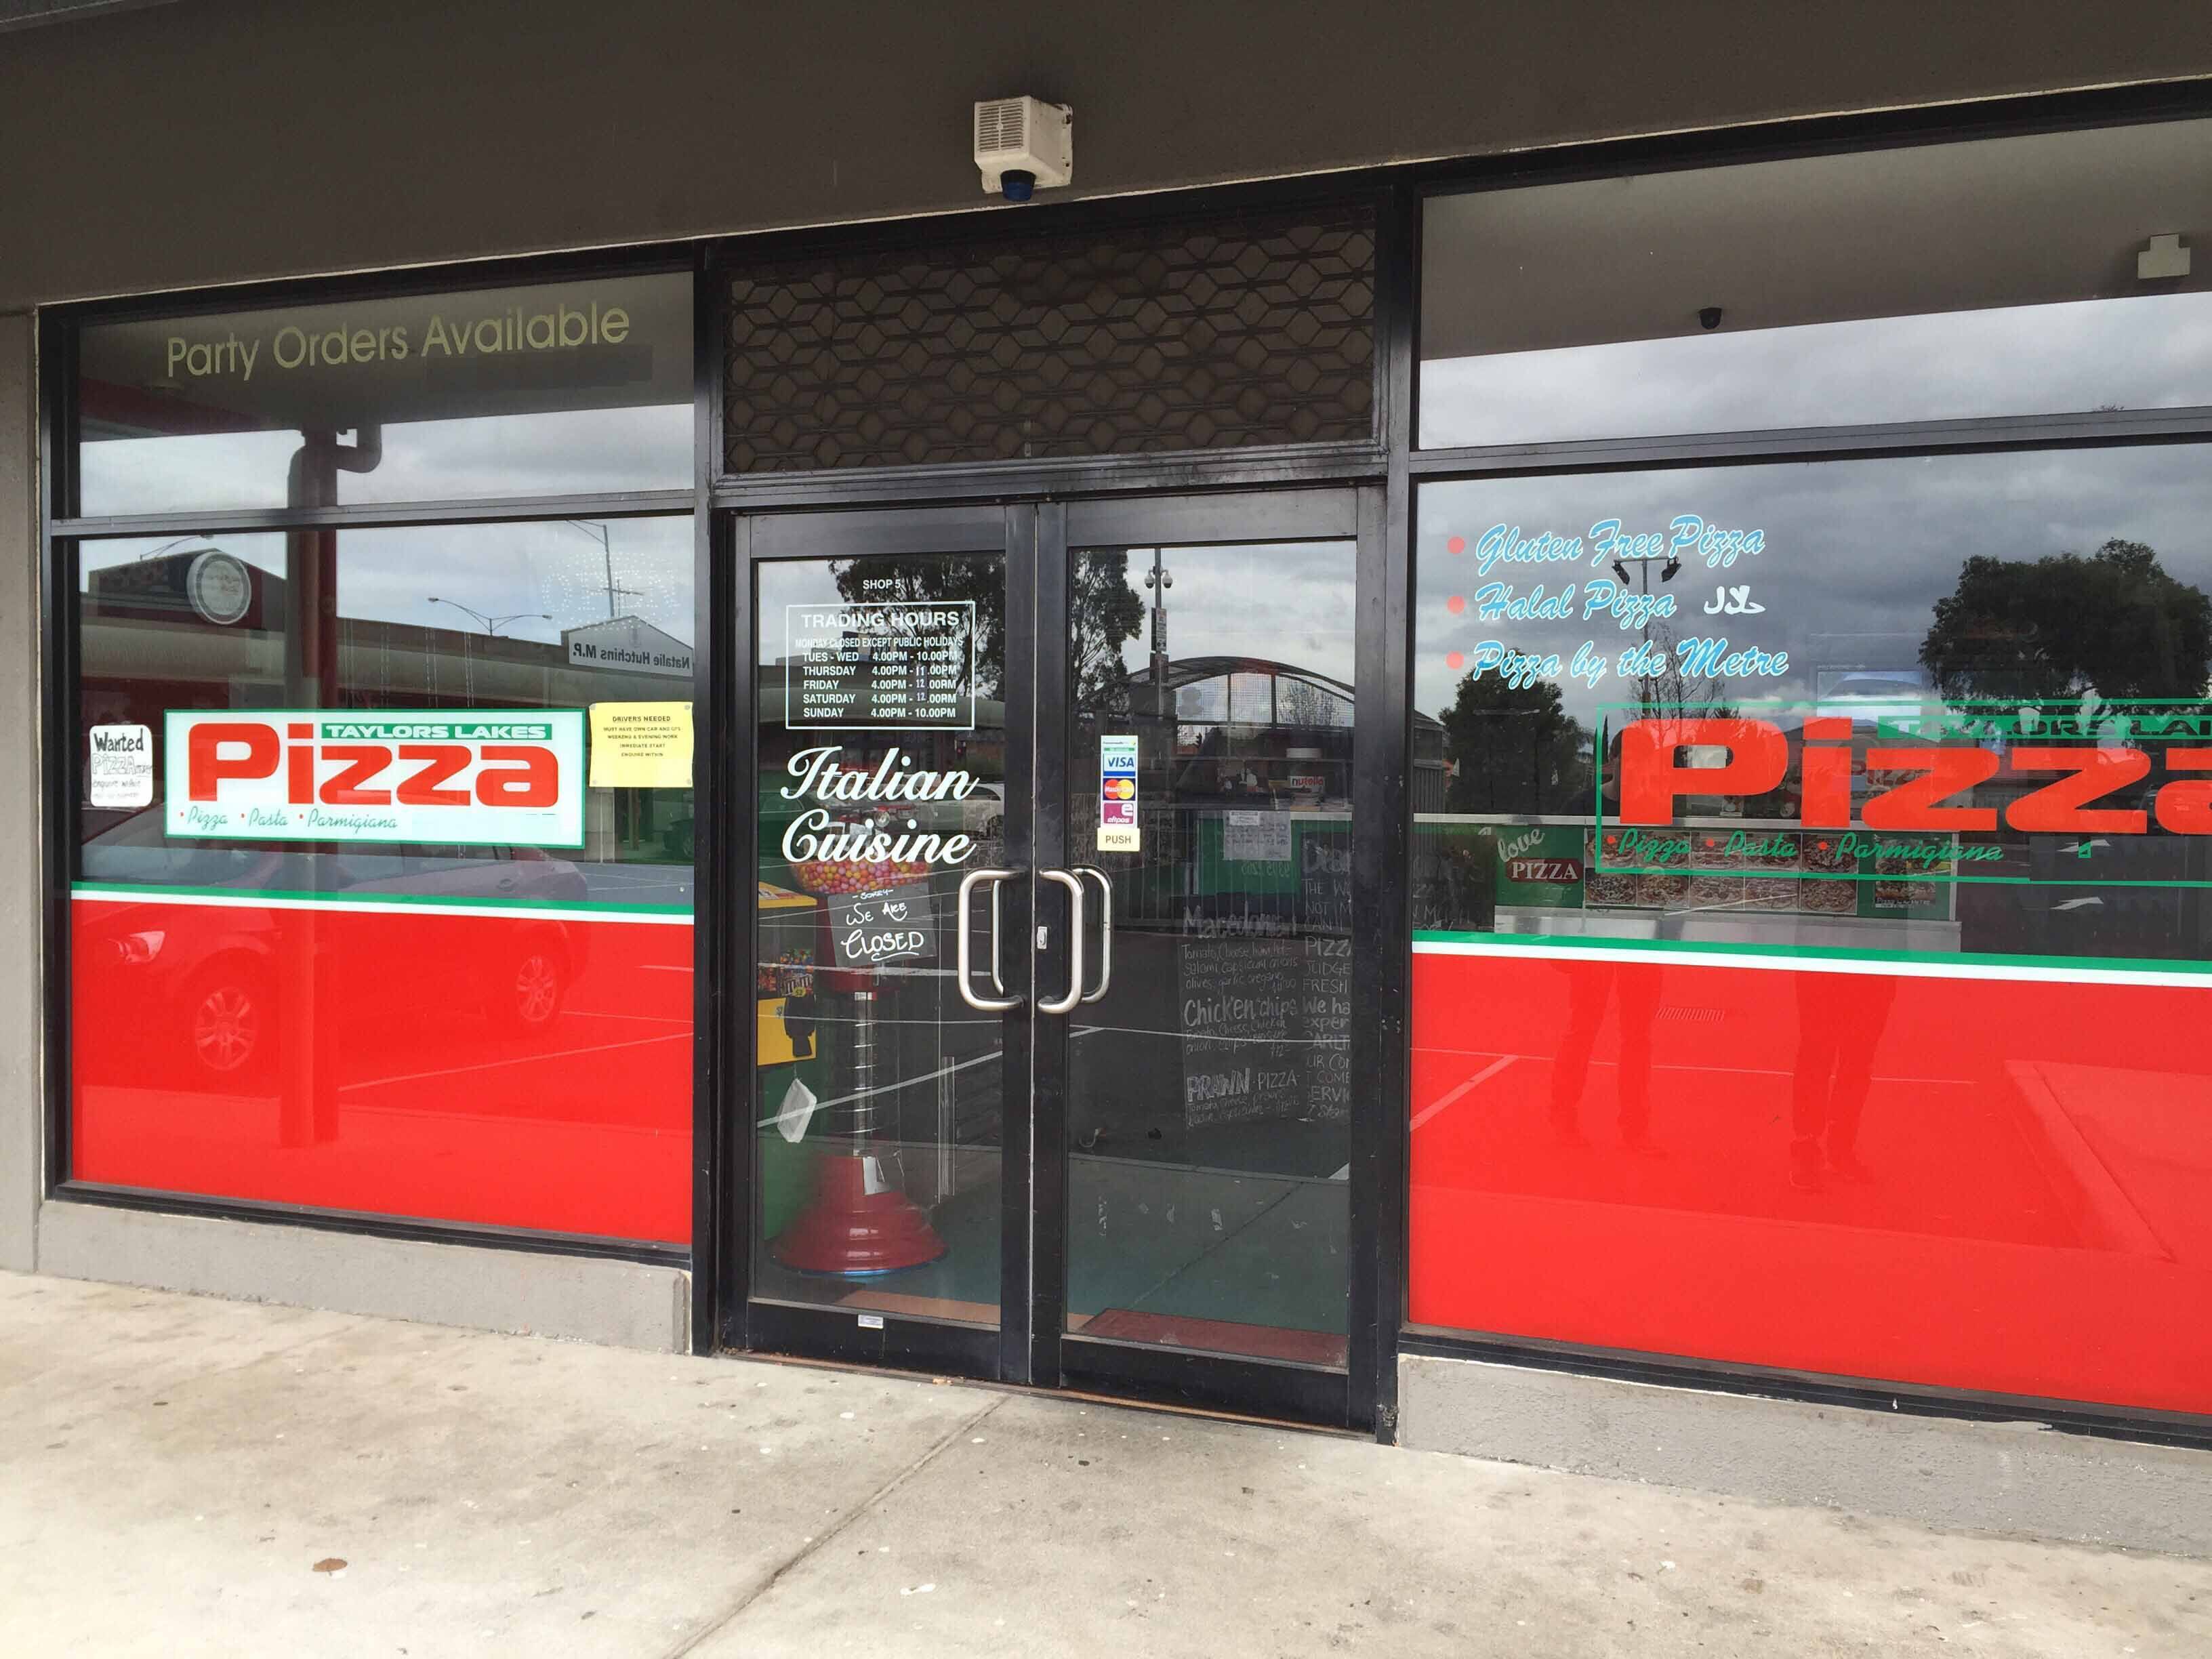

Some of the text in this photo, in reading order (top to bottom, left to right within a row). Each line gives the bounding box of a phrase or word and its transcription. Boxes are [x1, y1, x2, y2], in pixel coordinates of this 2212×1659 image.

[168, 302, 630, 381] Party Orders Available
[1475, 514, 1765, 576] Gluten Free Pizza
[863, 579, 901, 590] SHOP 5
[1475, 579, 1677, 630] Halal Pizza
[801, 611, 960, 628] TRADING HOURS
[795, 636, 964, 648] MONDAY CLOSED EXCEPT PUBLIC HOLIDAYS
[802, 653, 828, 662] TUES
[836, 652, 859, 661] WED
[872, 652, 907, 661] 4.00PM
[917, 651, 958, 661] 10.00PM
[1473, 637, 1789, 690] Pizza by the Metre
[803, 666, 856, 676] THURSDAY
[872, 665, 907, 675] 4.00PM
[916, 665, 957, 676] 11.00PM
[804, 680, 839, 690] FRIDAY
[872, 680, 906, 689] 4.00PM
[803, 694, 856, 703] SATURDAY
[872, 694, 906, 703] 4.00PM
[803, 708, 844, 718] SUNDAY
[871, 708, 906, 718] 4.00PM
[915, 708, 956, 718] 10.00PM
[94, 727, 144, 753] Wanted
[326, 725, 547, 739] TAYLORS LAKES
[188, 722, 558, 808] Pizza
[1107, 757, 1134, 767] VISA
[780, 746, 980, 802] Italian
[187, 806, 398, 834] Pizza Pasta Parmigiana
[781, 808, 977, 864] Cuisine
[1105, 835, 1132, 844] PUSH
[1497, 828, 1545, 863] love
[1619, 827, 2004, 868] Pizza Pasta Parmigiana
[1512, 861, 1578, 880] PIZZA
[1303, 979, 1347, 994] FRESH
